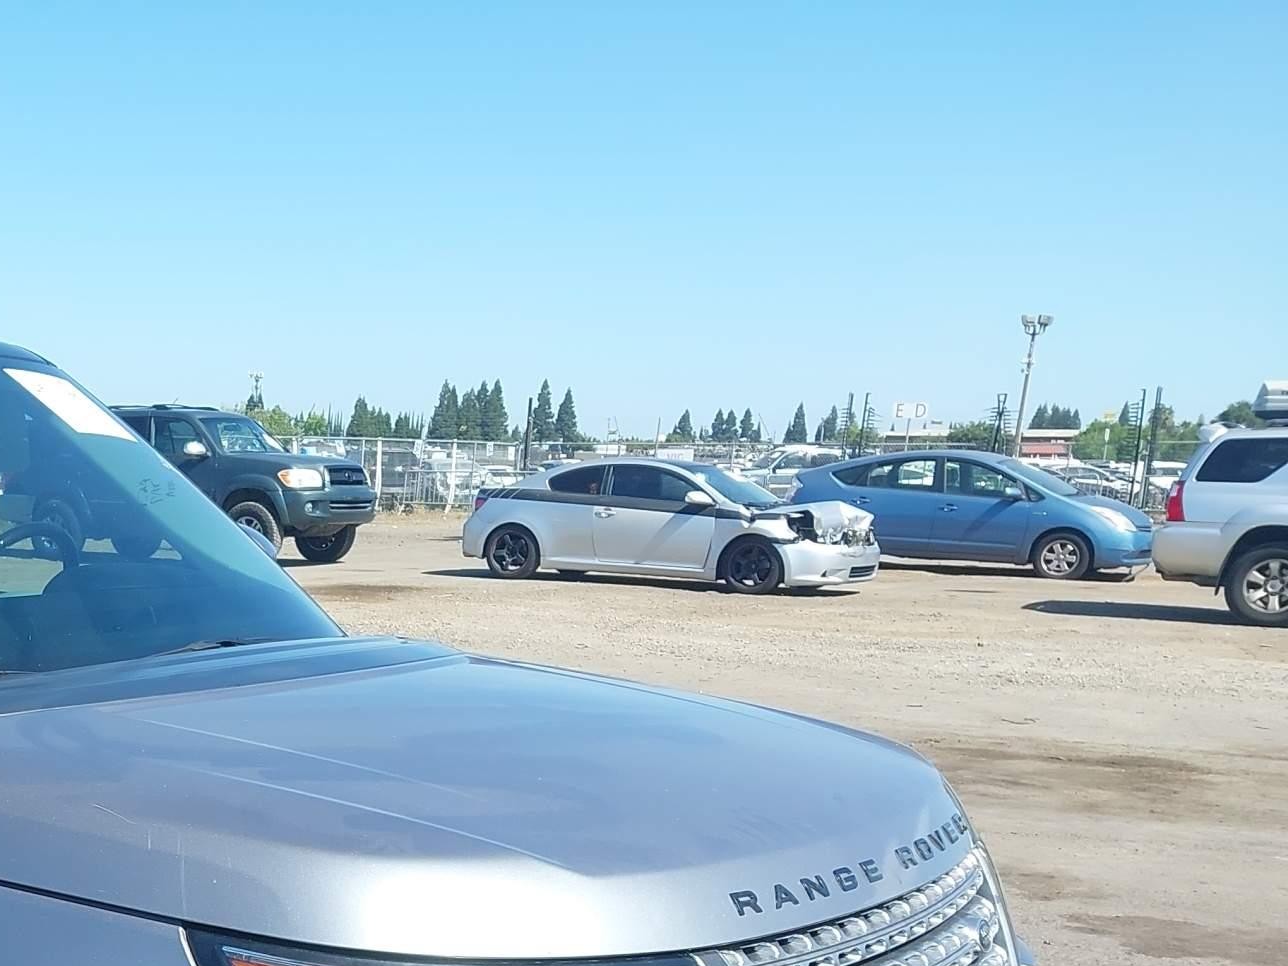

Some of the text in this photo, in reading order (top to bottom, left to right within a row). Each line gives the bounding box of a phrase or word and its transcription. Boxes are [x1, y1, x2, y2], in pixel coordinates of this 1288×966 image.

[896, 403, 927, 418] E D
[729, 813, 968, 916] RANGE ROVER
